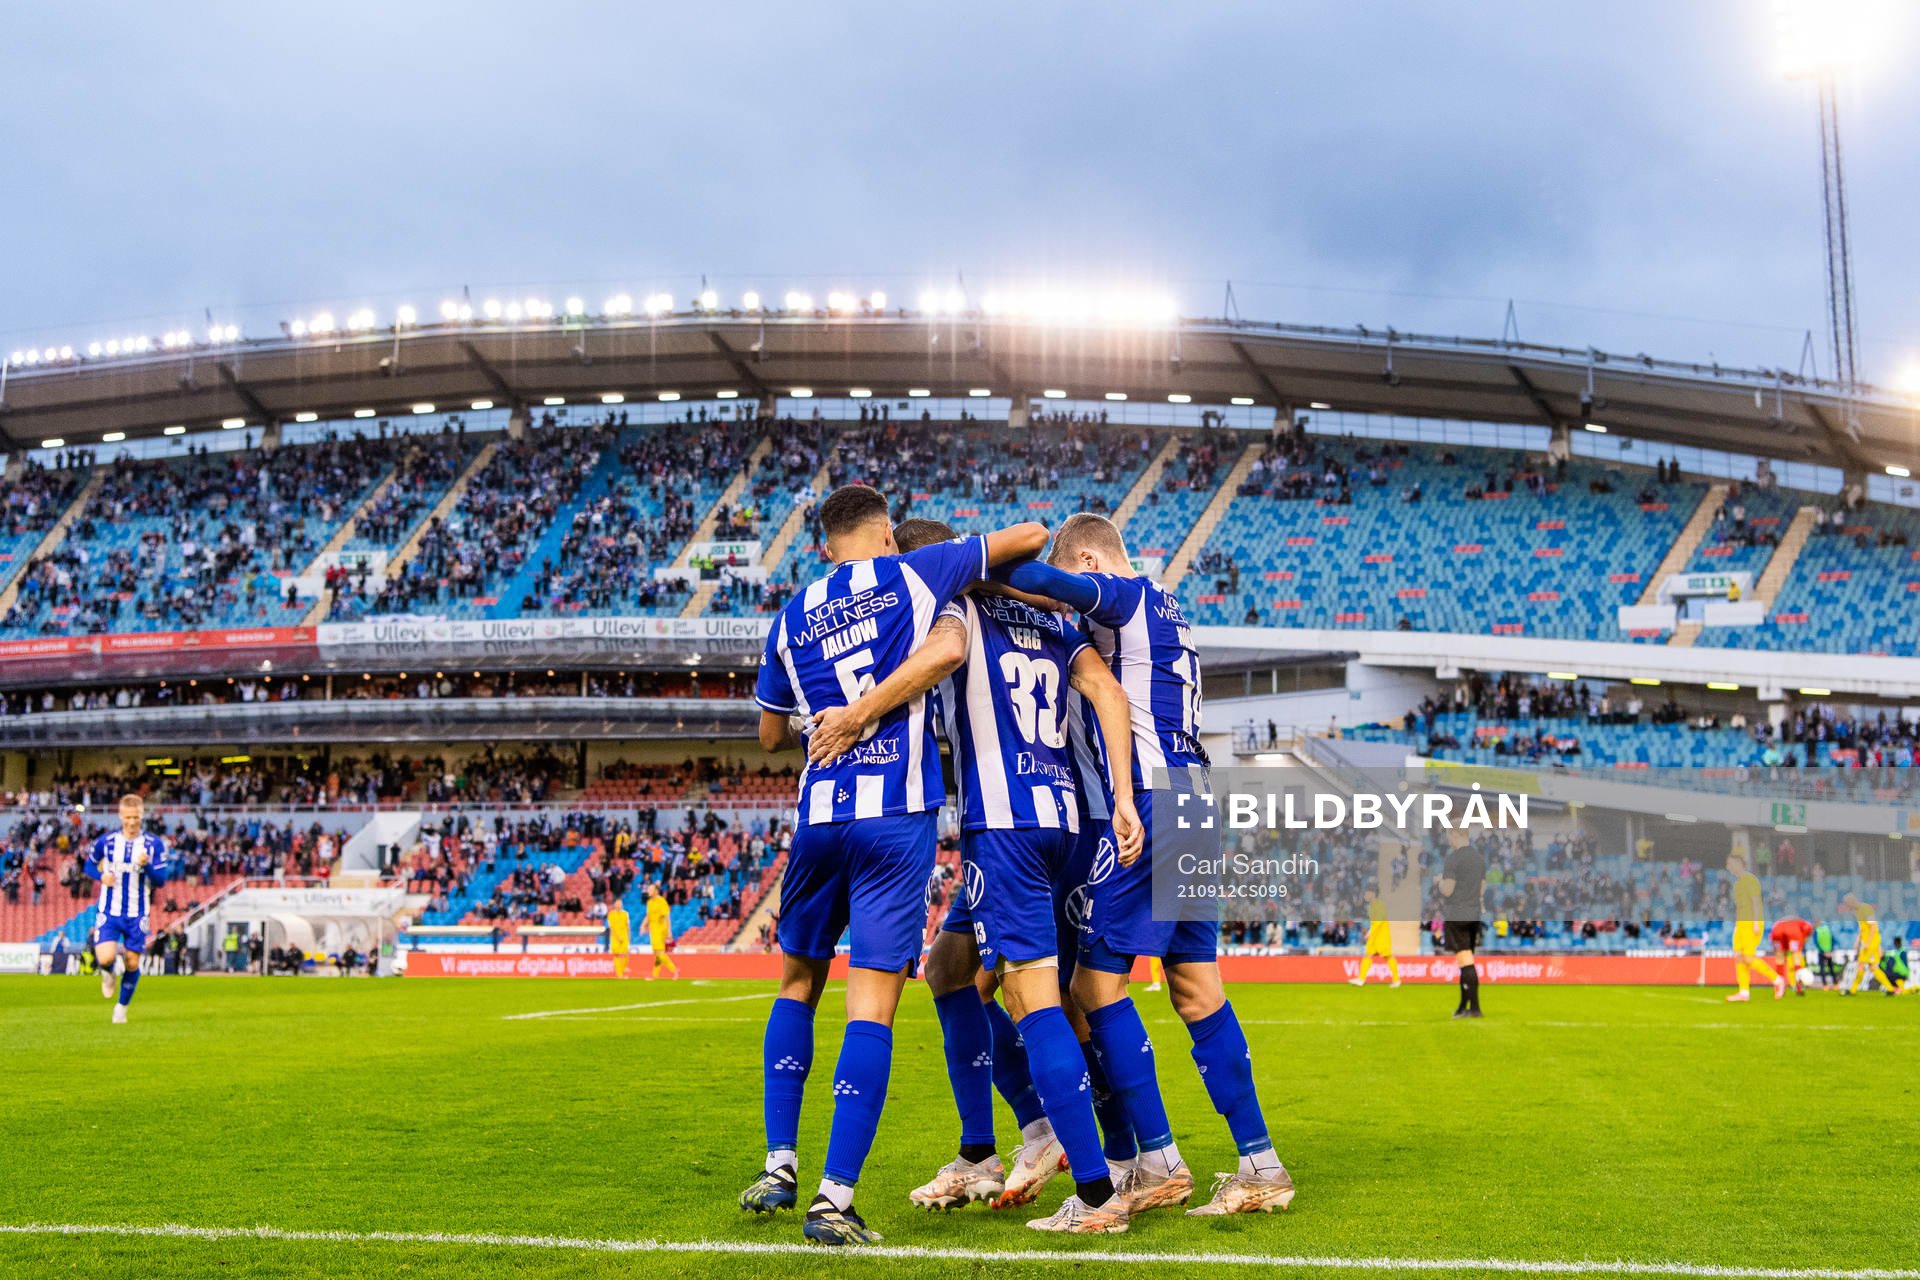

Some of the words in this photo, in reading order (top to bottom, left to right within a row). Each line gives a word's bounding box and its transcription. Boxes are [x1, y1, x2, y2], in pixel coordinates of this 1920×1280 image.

[482, 622, 535, 638] Ullevi
[593, 619, 646, 636] Ullevi
[705, 619, 760, 637] Ullevi
[794, 592, 899, 647] WELLNESS
[374, 624, 425, 641] Ullevi
[821, 617, 879, 661] JALLOW
[999, 652, 1068, 749] 33
[440, 956, 456, 973] Vi
[457, 959, 516, 976] anpassar
[517, 957, 566, 977] digitala
[1365, 963, 1429, 981] anpssar
[1430, 960, 1484, 981] digia
[1486, 959, 1543, 981] tjänster
